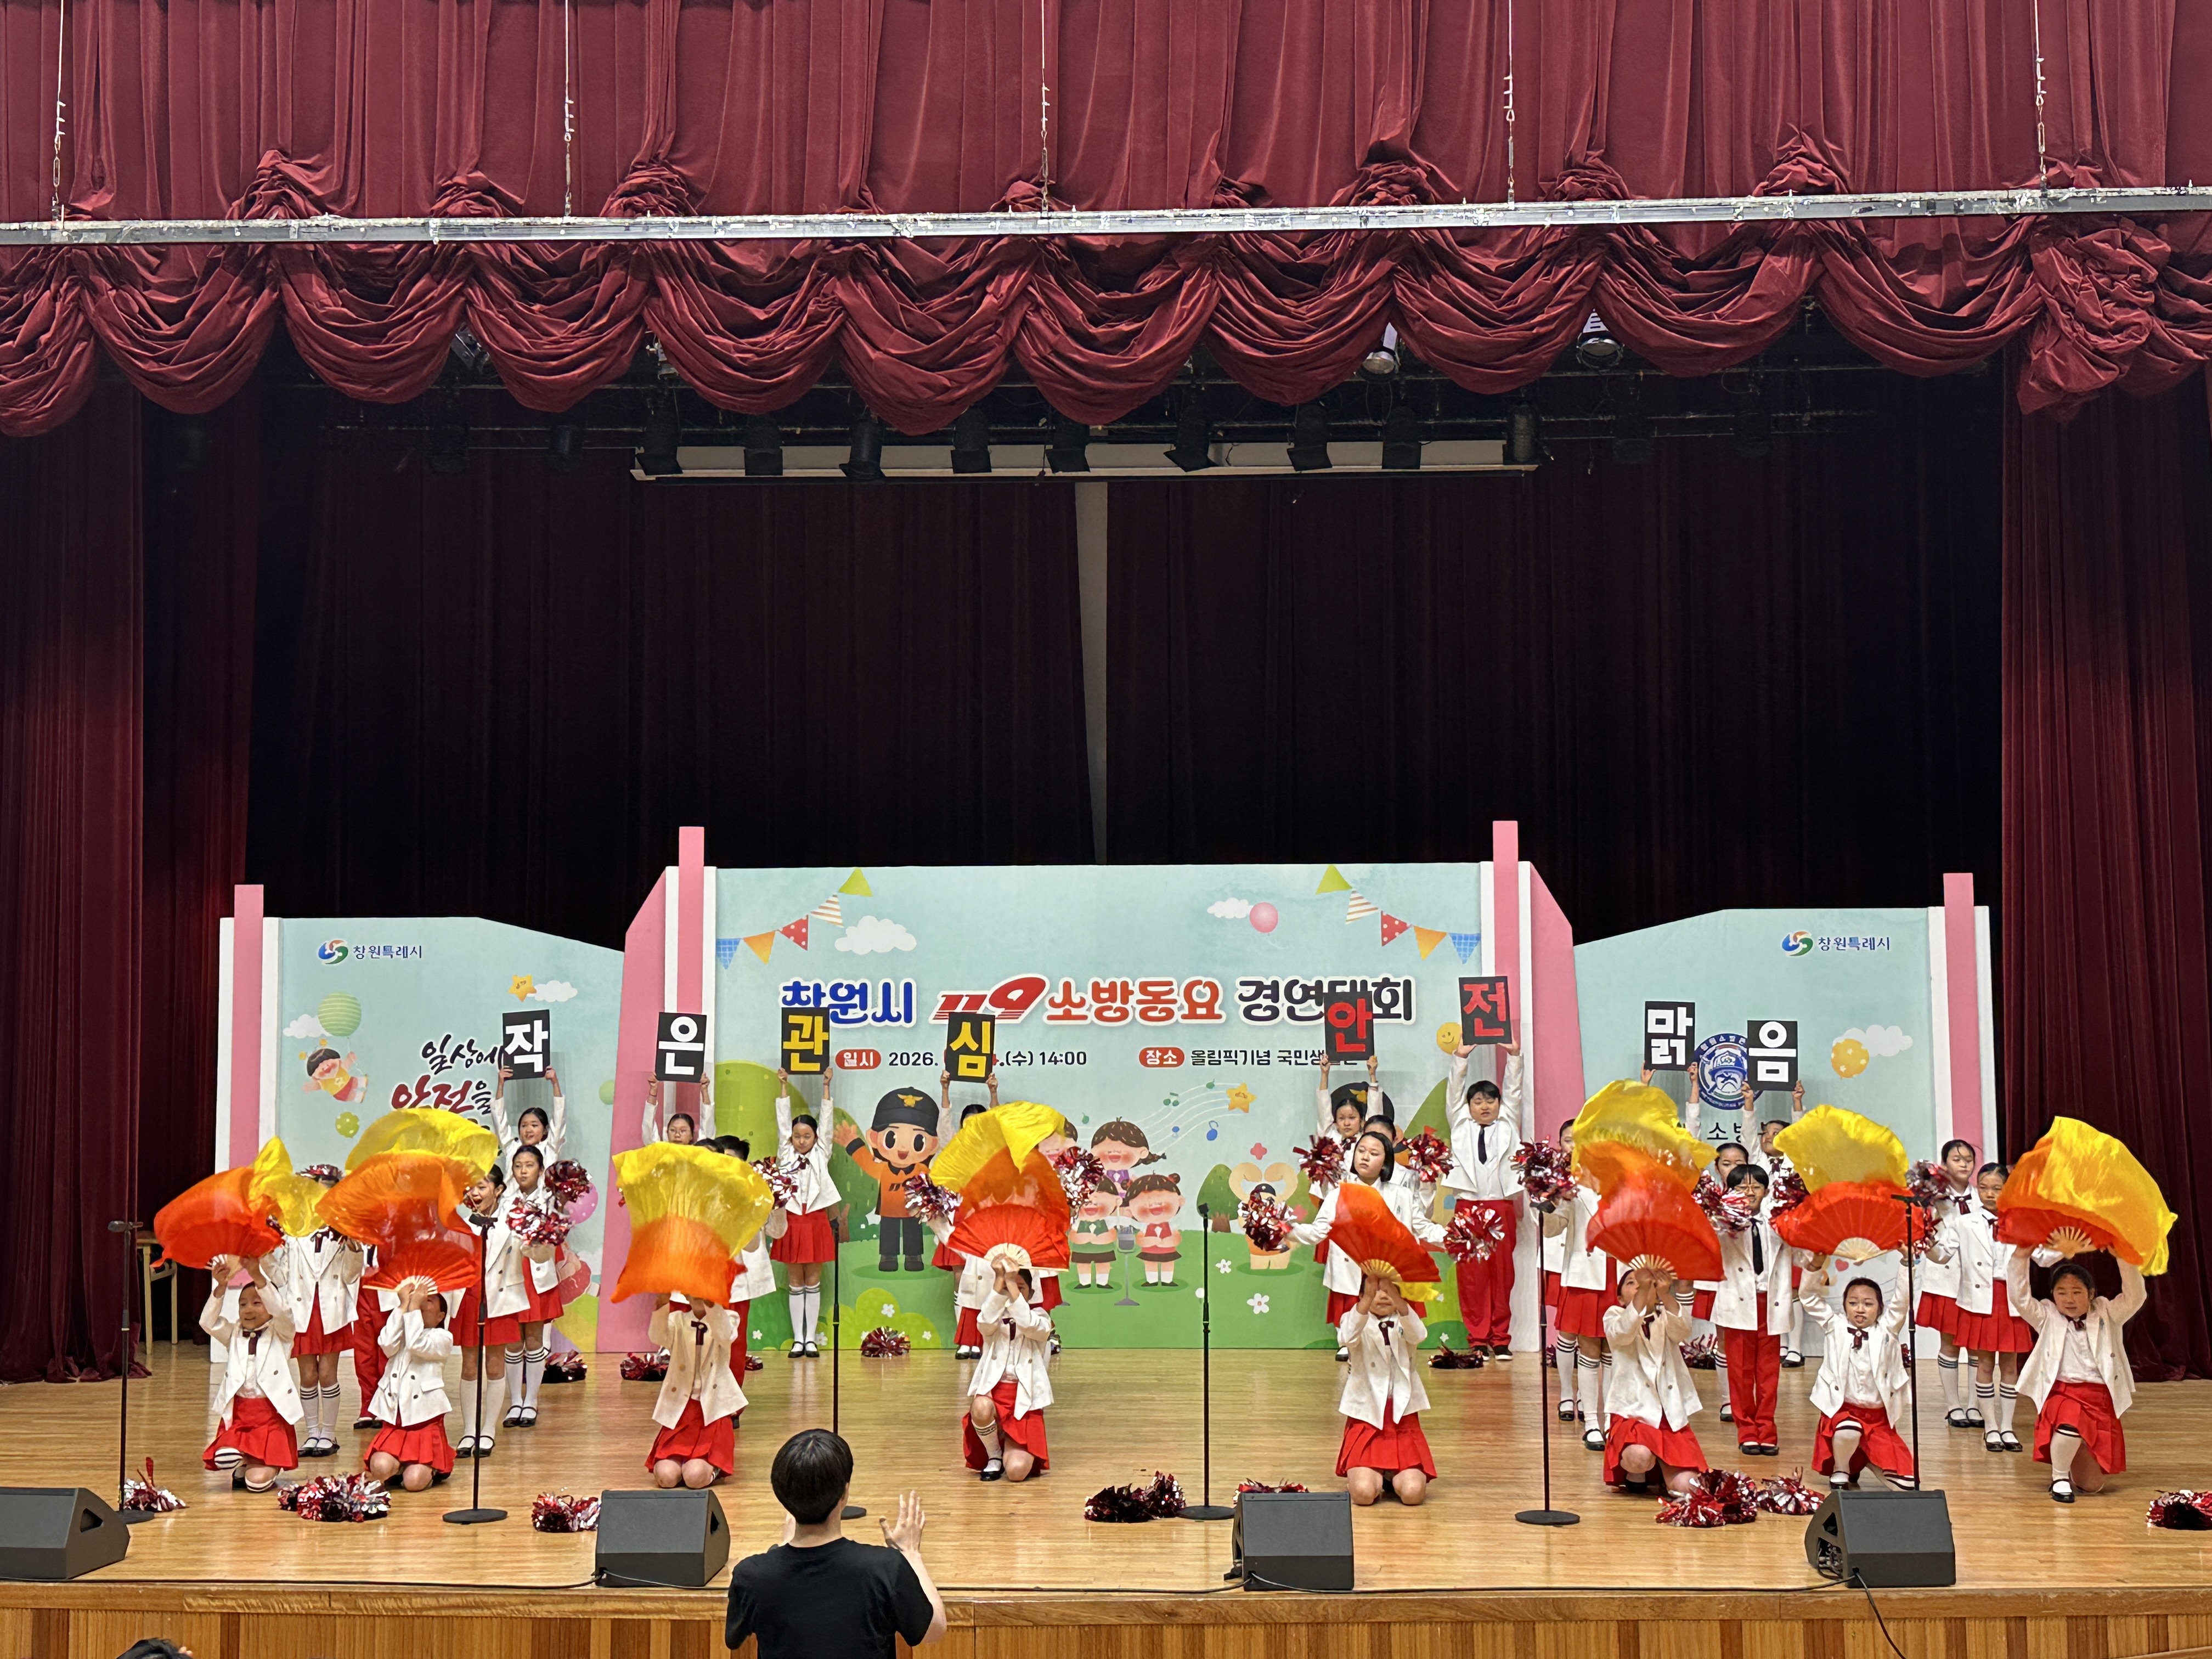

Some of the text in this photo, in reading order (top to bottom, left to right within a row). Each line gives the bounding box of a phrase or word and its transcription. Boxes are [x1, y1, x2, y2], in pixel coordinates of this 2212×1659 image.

[1238, 977, 1412, 1022] 경연회
[1327, 998, 1373, 1053] 안
[1463, 983, 1508, 1037] 전
[504, 1019, 549, 1073] 작
[659, 1015, 706, 1075] 은
[783, 1014, 829, 1071] 관
[843, 1051, 874, 1067] 일시
[889, 1052, 938, 1066] 2026.
[1040, 1051, 1087, 1066] 14:00
[949, 1021, 991, 1077] 심
[1146, 1049, 1178, 1065] 장소
[1190, 1049, 1271, 1066] 올림픽기념
[1647, 1006, 1694, 1066] 맑
[1748, 1021, 1797, 1083] 음
